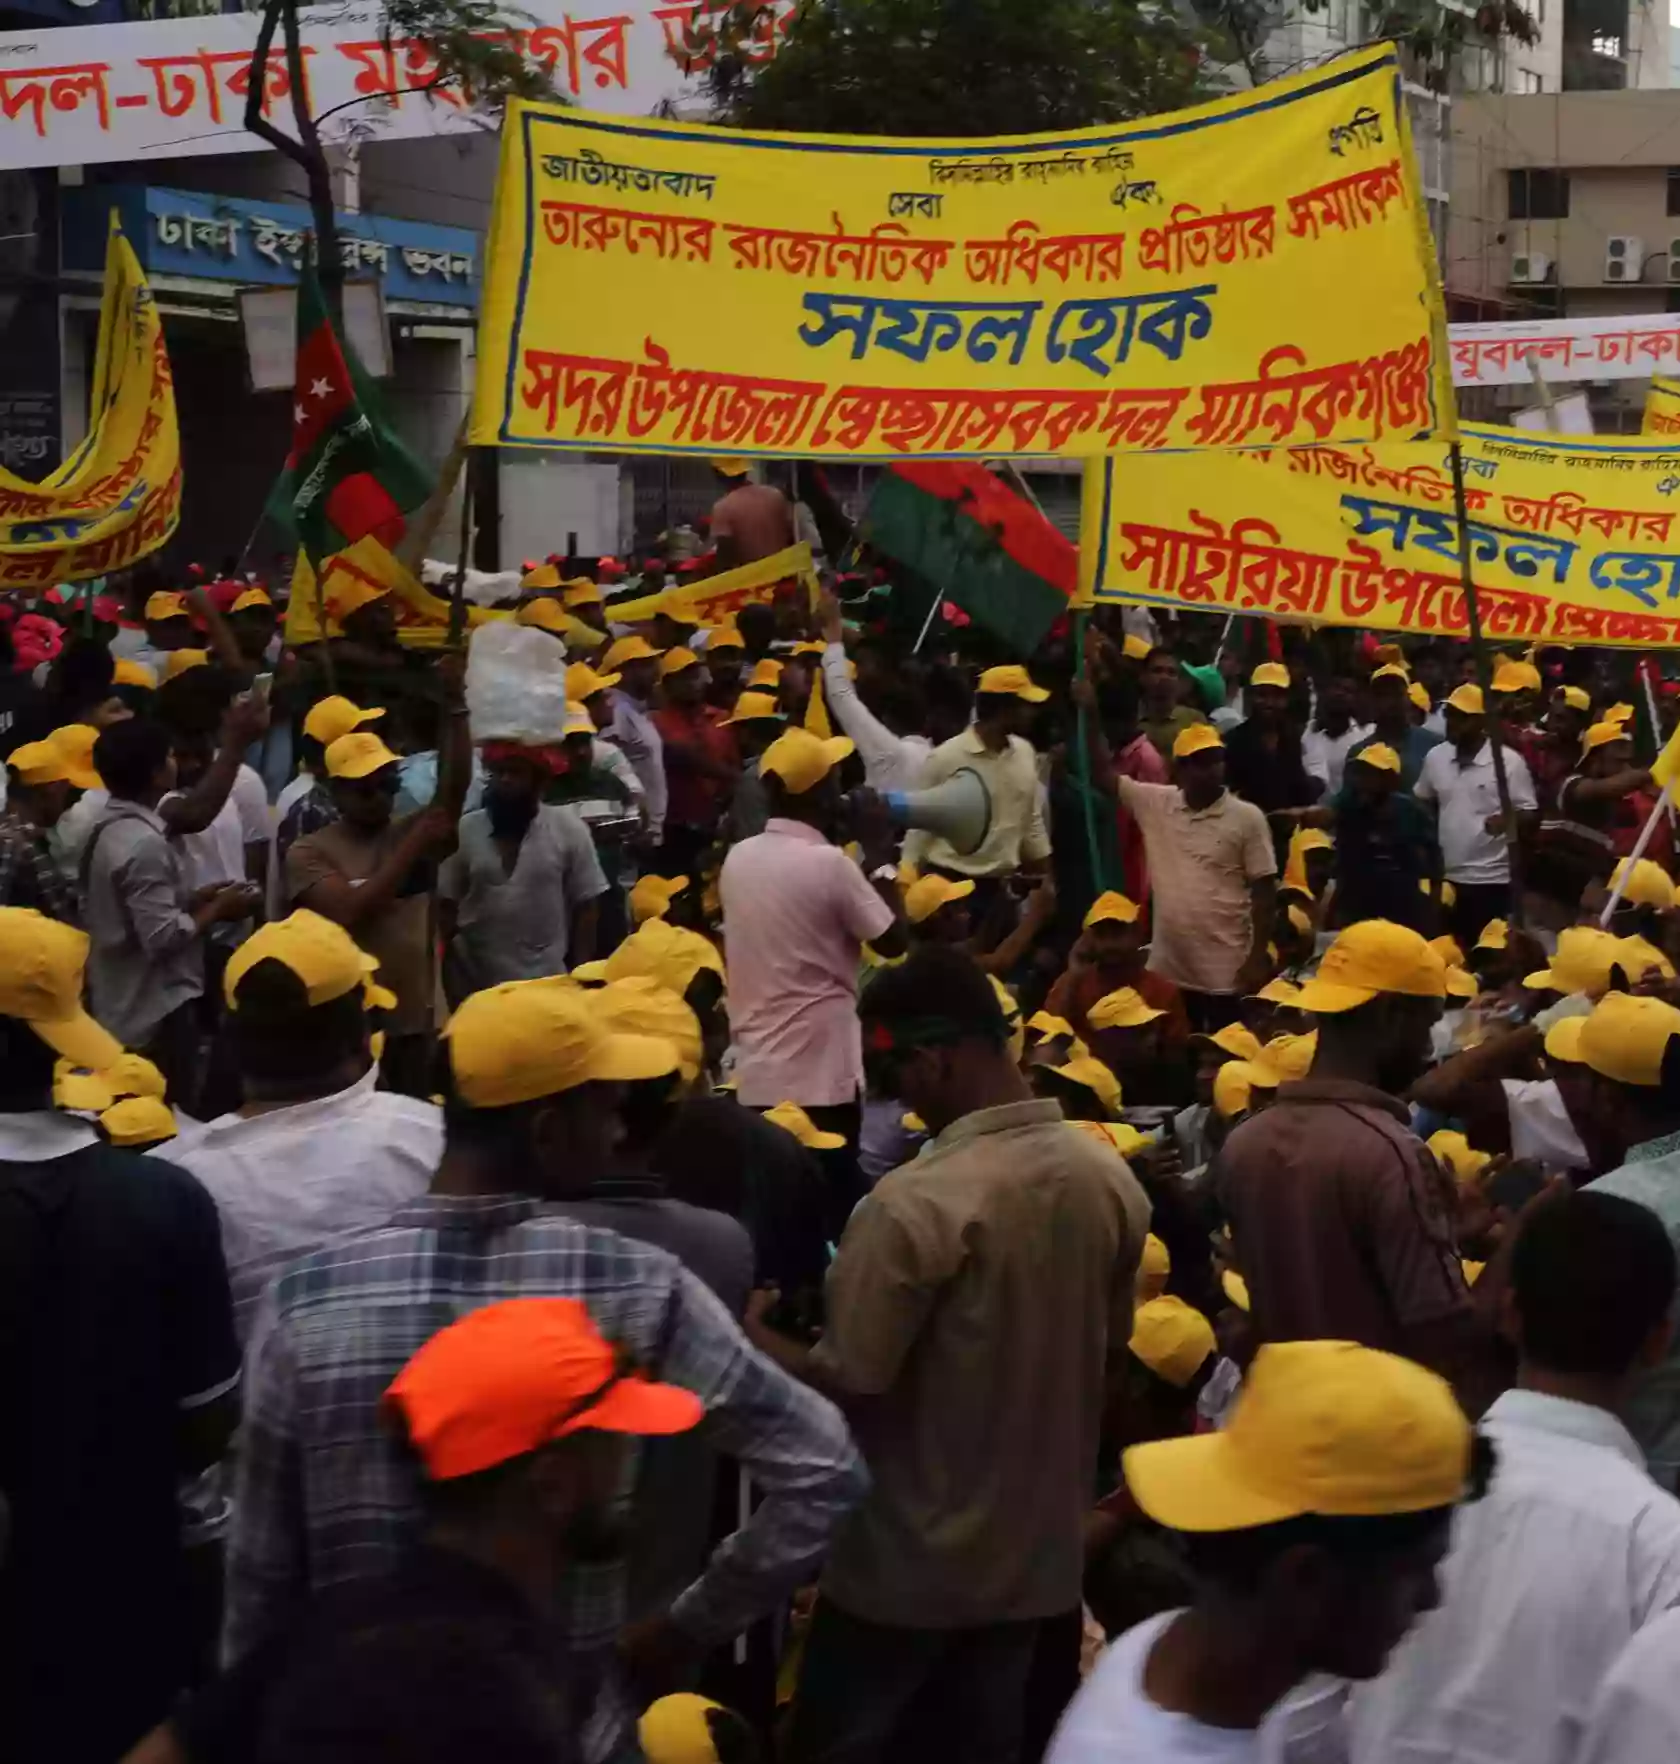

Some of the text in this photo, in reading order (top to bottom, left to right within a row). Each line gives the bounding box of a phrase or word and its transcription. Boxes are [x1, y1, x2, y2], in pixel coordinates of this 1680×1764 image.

[0, 46, 318, 137] দল-ঢাকা
[156, 211, 243, 257] ঢাকা
[401, 245, 474, 284] ভবন
[540, 158, 1410, 287] তারুন্যের রাজনৈতিক অধিকার প্রতিষ্ঠার সমাবেশ
[889, 192, 945, 219] সেবা
[797, 284, 1219, 377] সফল হোক
[808, 384, 1103, 453] স্বেচ্ছাসেবক
[1339, 494, 1581, 584] সফল
[1502, 490, 1677, 543] অধিকার
[1119, 508, 1341, 614] সাটুরিয়া
[1338, 538, 1552, 638] উপজেলা
